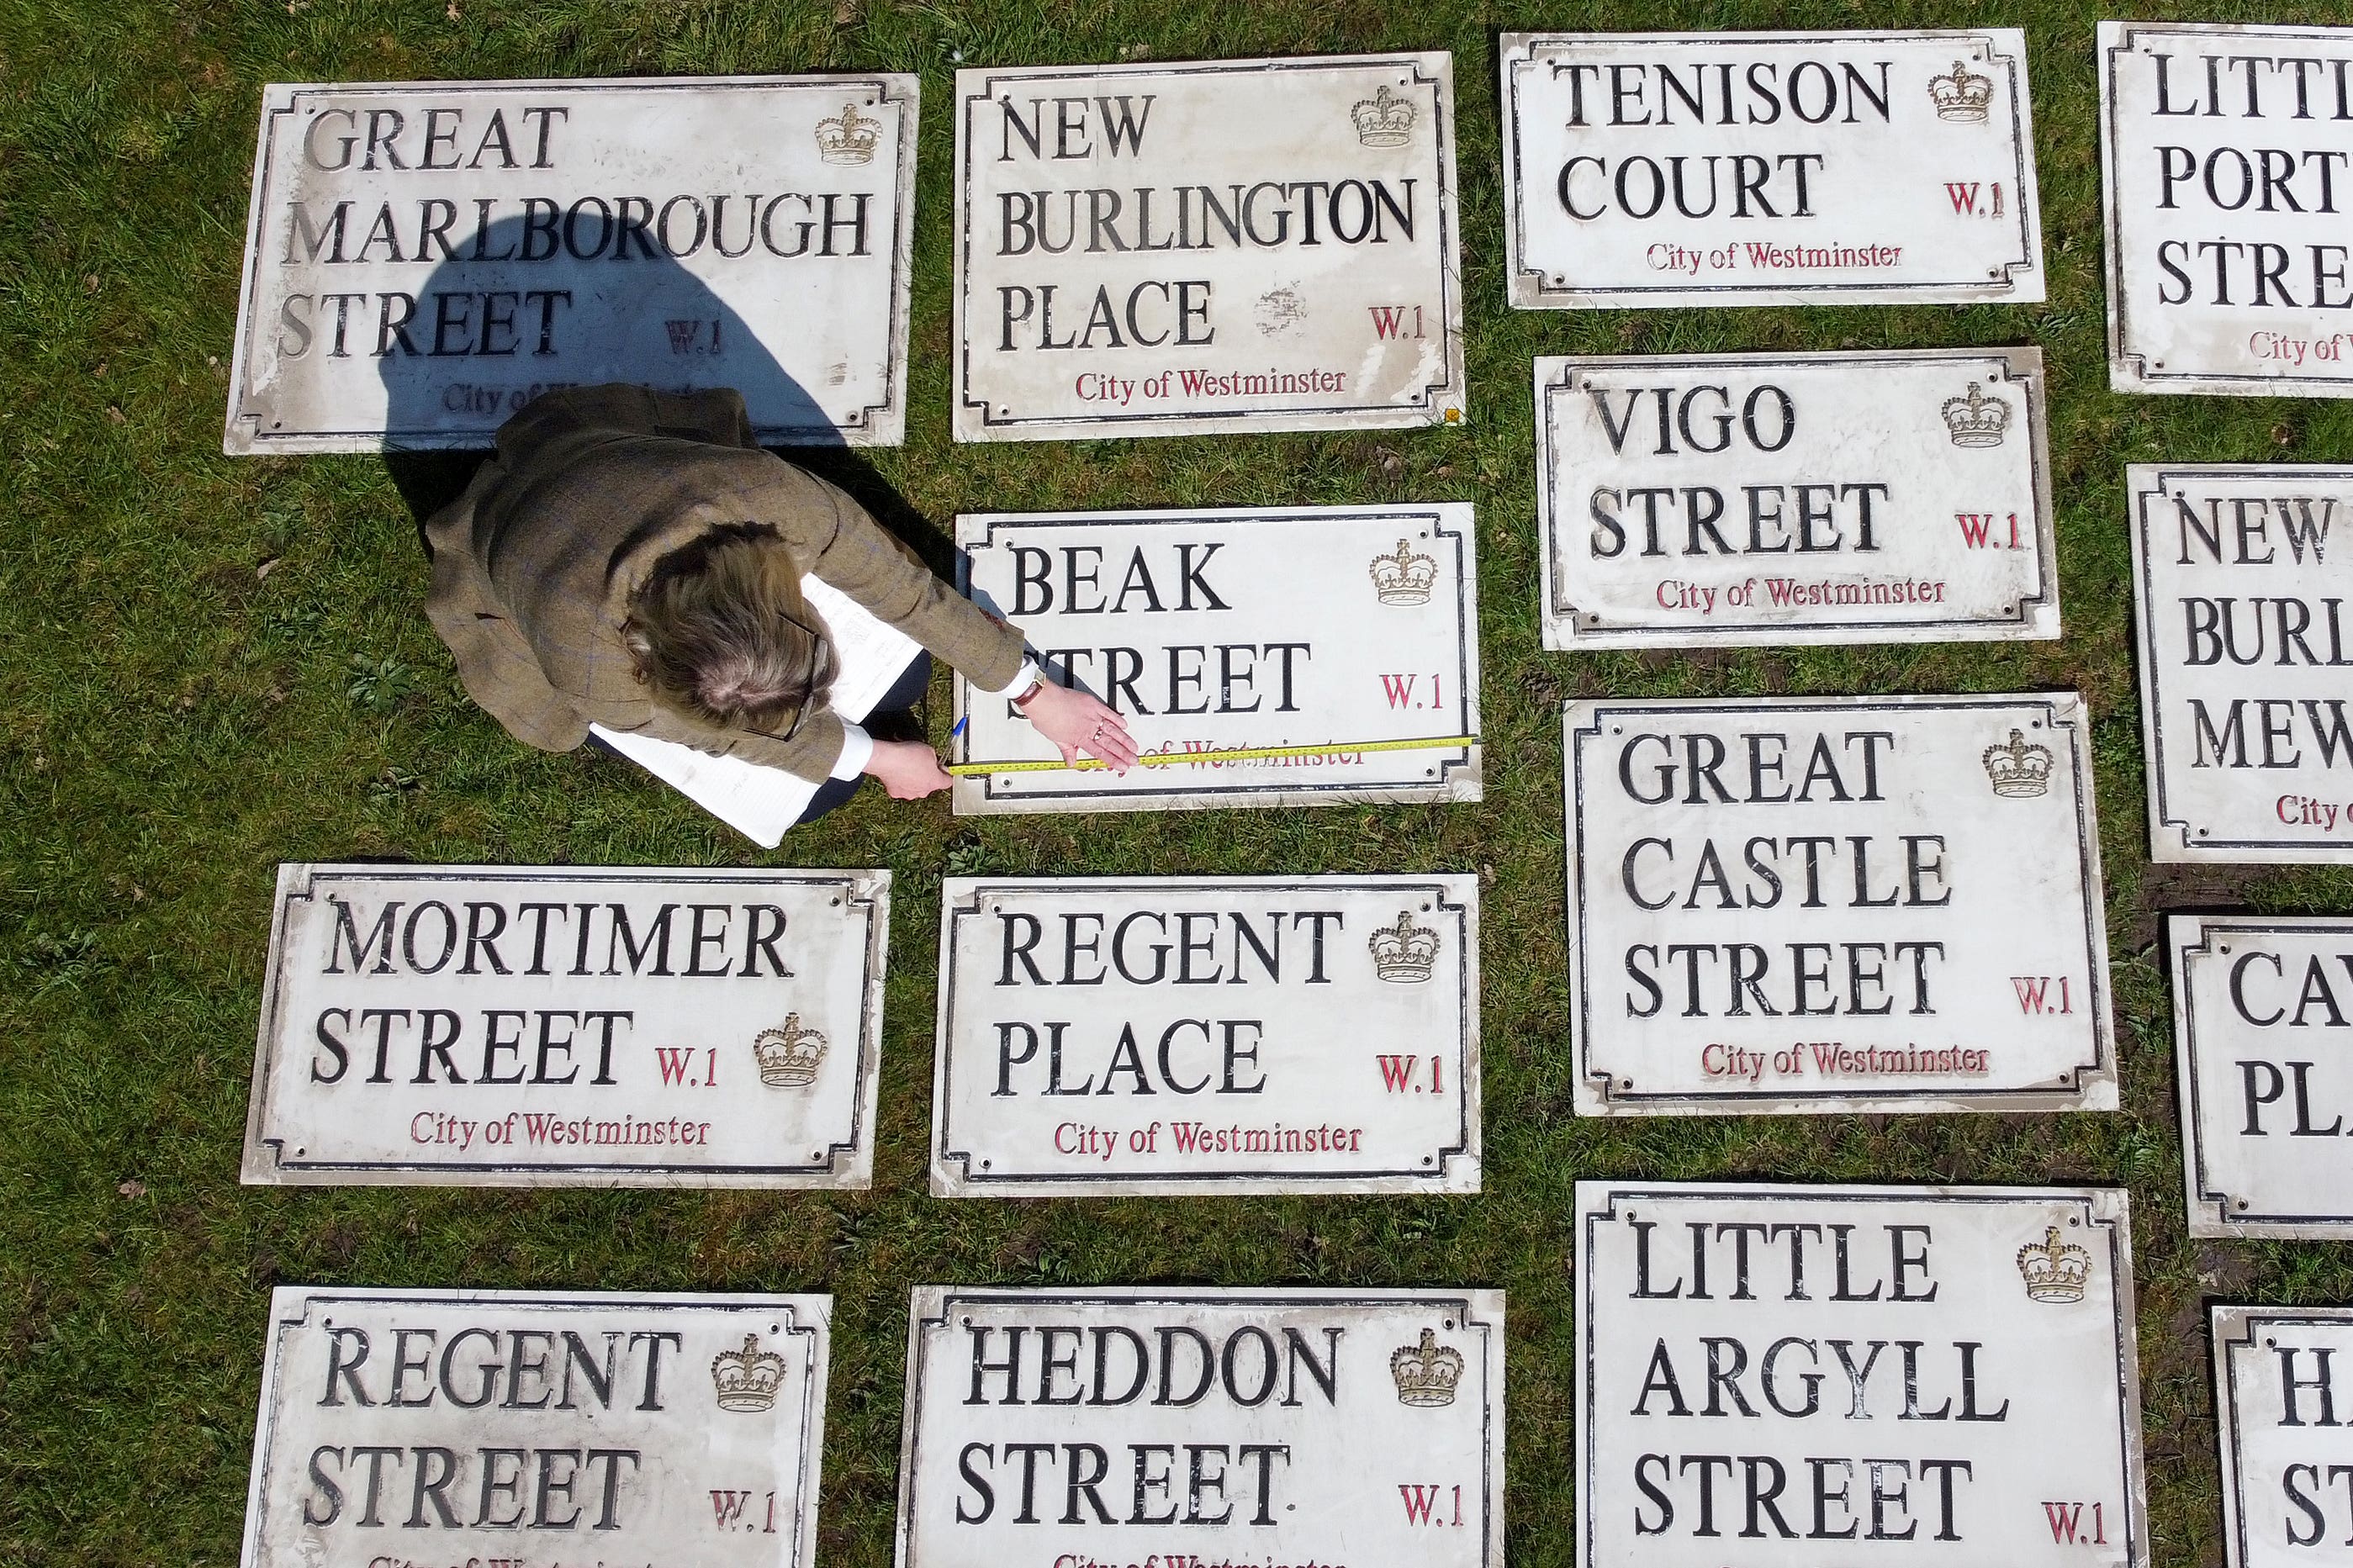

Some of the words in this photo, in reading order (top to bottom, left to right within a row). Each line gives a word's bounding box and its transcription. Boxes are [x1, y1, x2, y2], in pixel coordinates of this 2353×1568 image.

[1552, 61, 1893, 127] TENISON
[304, 107, 568, 172] GREAT
[997, 95, 1156, 161] NEW
[997, 178, 1417, 256] BURLINGTON
[1557, 154, 1824, 220] COURT
[1943, 182, 2004, 219] W.1
[280, 193, 872, 266] MARLBOROUGH
[1646, 243, 1702, 275] City
[1709, 242, 1739, 270] of
[1743, 241, 1902, 267] Westminster
[2158, 240, 2353, 309] STRE
[278, 289, 572, 360] STREET
[666, 319, 721, 354] W.1
[997, 280, 1215, 351] PLACE
[1367, 306, 1425, 340] W.1
[2250, 331, 2308, 366] City
[2314, 334, 2344, 361] of
[442, 383, 502, 414] City
[1076, 373, 1135, 406] City
[1144, 370, 1174, 399] of
[1179, 368, 1346, 397] Westminster
[1587, 385, 1795, 457] VIGO
[1590, 483, 1890, 559] STREET
[1956, 515, 2019, 550] W.1
[2171, 498, 2337, 565] NEW
[1008, 542, 1232, 615] BEAK
[1657, 580, 1716, 615] City
[1727, 578, 1758, 608] of
[1764, 578, 1945, 605] Westminster
[1379, 673, 1443, 709] W.1
[2187, 700, 2353, 768] MEW
[1619, 731, 1893, 805] GREAT
[2276, 795, 2339, 832] City
[1621, 835, 1952, 911] CASTLE
[322, 900, 795, 979] MORTIMER
[994, 911, 1344, 986] REGENT
[1626, 942, 1945, 1018] STREET
[2009, 976, 2073, 1015] W.1
[310, 1008, 633, 1085] STREET
[655, 1047, 716, 1088] W.1
[991, 1019, 1267, 1097] PLACE
[1377, 1054, 1443, 1094] W.1
[1702, 1044, 1763, 1081] City
[1774, 1043, 1803, 1074] of
[1809, 1043, 1991, 1073] Westminster
[410, 1112, 477, 1152] City
[484, 1113, 520, 1146] of
[523, 1113, 711, 1146] Westminster
[2234, 1061, 2353, 1136] PL
[1054, 1122, 1118, 1160] City
[1129, 1121, 1161, 1153] of
[1171, 1122, 1363, 1153] Westminster
[1629, 1222, 1938, 1302] LITTLE
[315, 1328, 681, 1412] REGENT
[963, 1326, 1344, 1408] HEDDON
[1631, 1338, 2009, 1422] ARGYLL
[304, 1446, 640, 1531] STREET
[709, 1490, 775, 1534] W.1
[956, 1443, 1292, 1527] STREET
[1399, 1484, 1464, 1527] W.1
[1634, 1454, 1972, 1542] STREET
[2041, 1502, 2107, 1545] W.1
